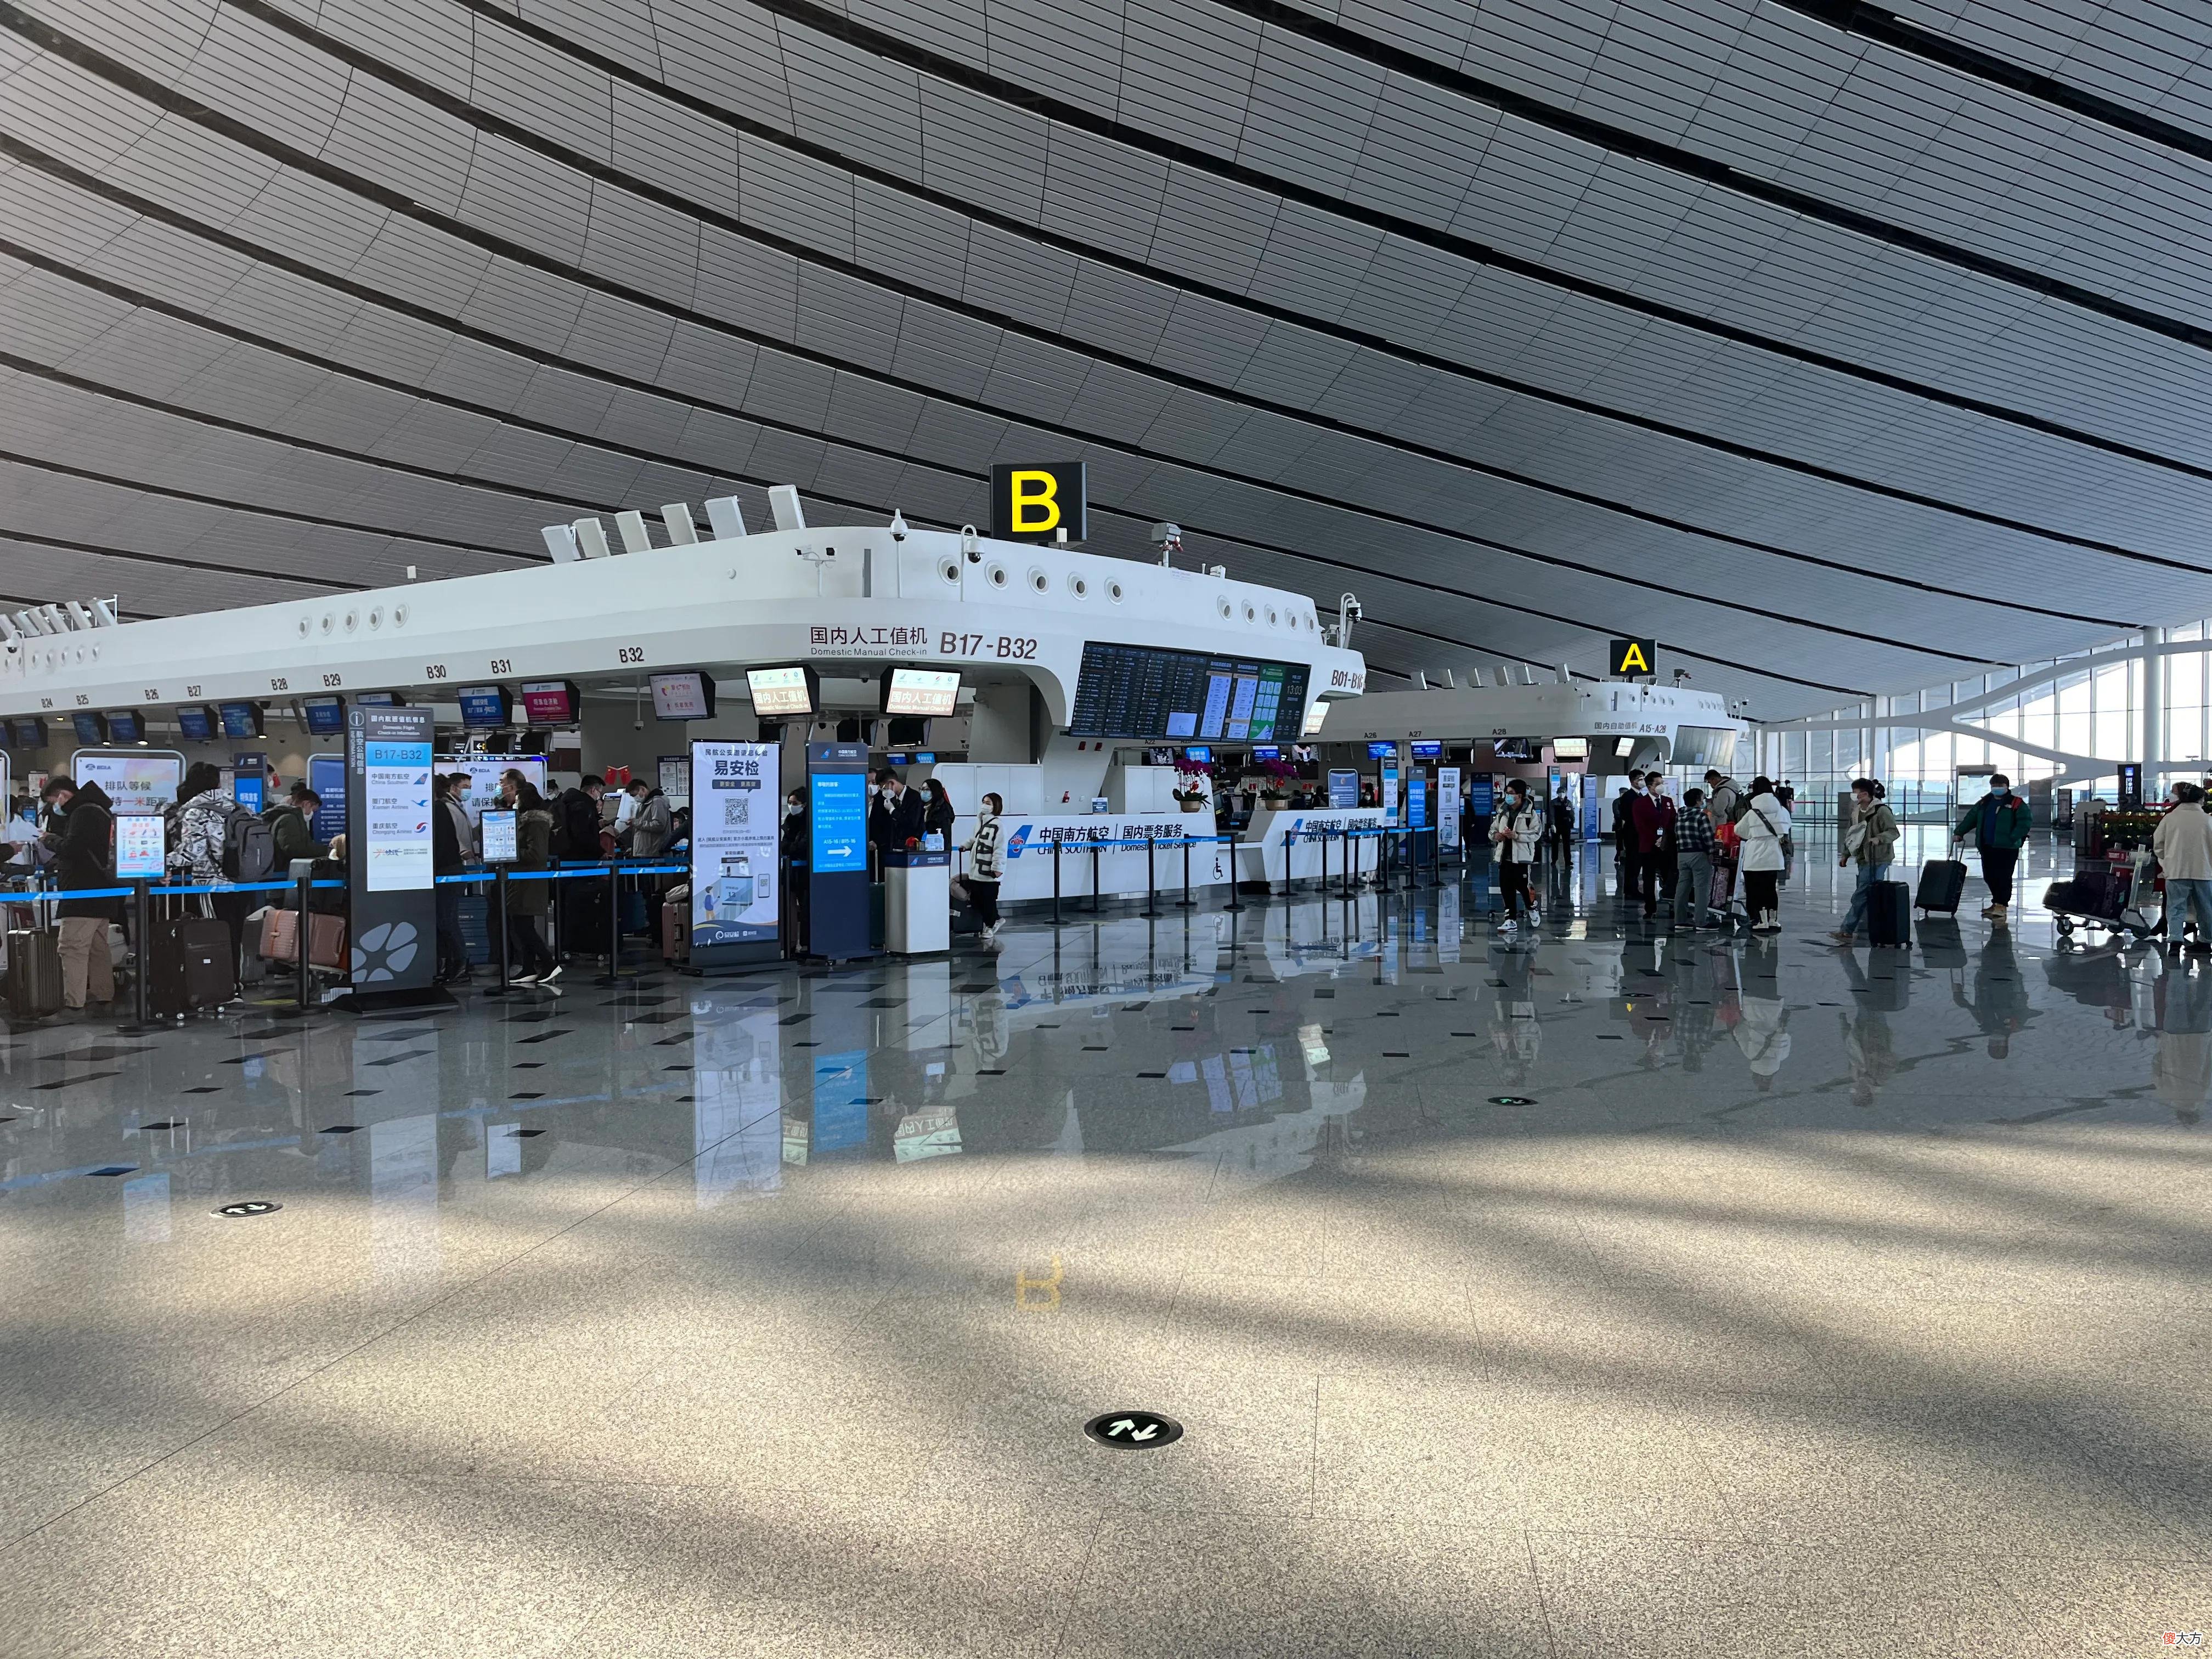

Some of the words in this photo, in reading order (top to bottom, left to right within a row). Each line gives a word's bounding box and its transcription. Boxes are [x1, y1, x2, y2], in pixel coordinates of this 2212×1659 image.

[1011, 470, 1061, 533] B
[810, 627, 928, 645] 国内人工值机
[619, 647, 644, 664] B32
[1620, 643, 1648, 672] A
[427, 664, 446, 679] B30
[491, 659, 511, 674] B31
[272, 678, 287, 690] B28
[323, 673, 341, 686] B29
[145, 689, 159, 700] B26
[187, 685, 201, 697] B27
[754, 690, 807, 704] 国内人工值机
[1287, 685, 1303, 696] 13:03
[76, 694, 89, 705] B25
[891, 691, 952, 705] 国内人工值机
[1594, 721, 1637, 730] 国内自助值机
[375, 749, 422, 760] B17-B32
[714, 760, 759, 776] 易安检
[105, 781, 151, 791] 排队等候
[1040, 826, 1109, 843] 中国南方航空
[1122, 823, 1183, 839] 国内票务服务
[1121, 843, 1151, 851] Domesti
